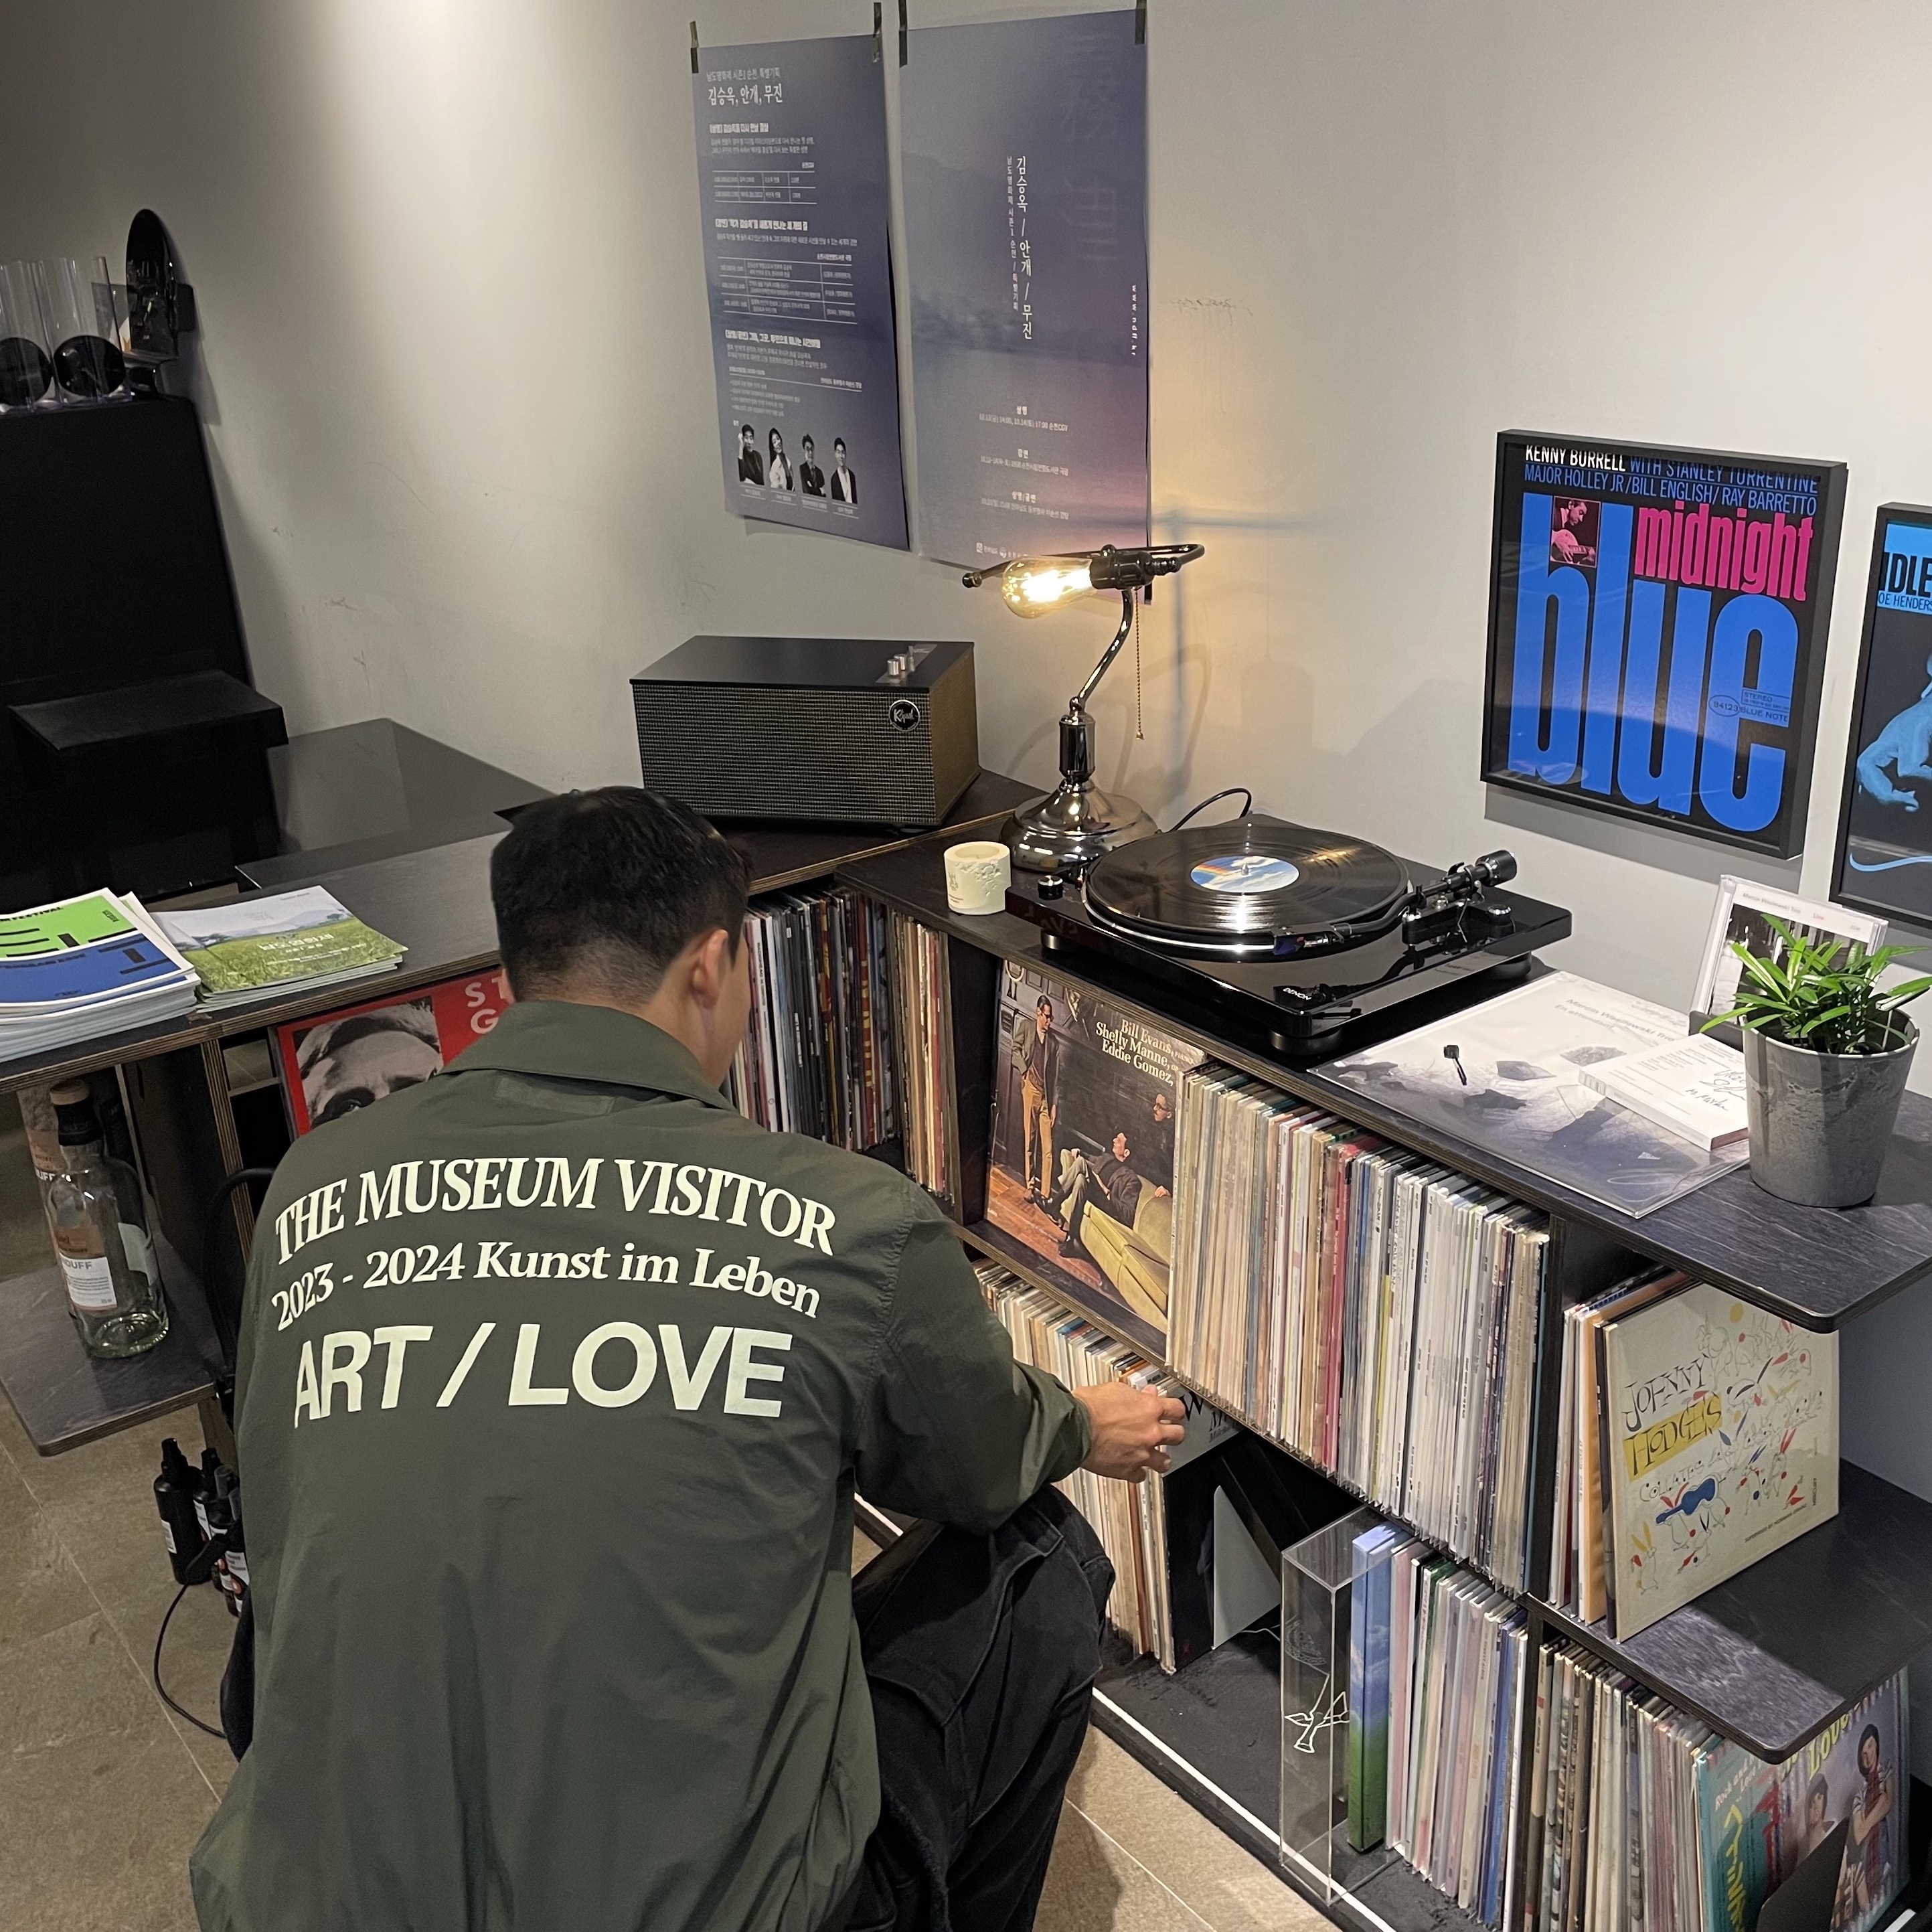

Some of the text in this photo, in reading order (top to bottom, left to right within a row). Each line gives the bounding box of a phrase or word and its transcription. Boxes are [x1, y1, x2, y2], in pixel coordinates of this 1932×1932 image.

[708, 83, 783, 106] 김승옥, 안개, 무진
[1016, 155, 1028, 213] 김승옥
[1020, 240, 1032, 276] 안개
[1022, 304, 1032, 339] 무진
[1526, 444, 1566, 465] KENNY
[1570, 449, 1626, 472] BURRELL
[1524, 463, 1562, 485] MAJOR
[1564, 469, 1609, 490] HOLLEY
[1721, 487, 1746, 507] RAY
[1748, 489, 1817, 517] BARRETTO
[1634, 499, 1814, 602] midnight
[1508, 492, 1799, 833] blue
[1740, 706, 1788, 722] BLUE NOTE
[1743, 692, 1773, 703] STEREO
[1096, 1022, 1129, 1050] Shelly
[1129, 1038, 1170, 1071] Manne,
[1102, 1038, 1174, 1086] Eddie Gomez,
[1121, 1019, 1139, 1039] Bill
[1141, 1028, 1175, 1057] Evans,
[275, 1157, 837, 1265] THE MUSEUM VISITOR
[271, 1262, 334, 1331] 2023
[363, 1242, 465, 1290] 2024
[474, 1240, 610, 1281] Kunst
[617, 1242, 679, 1283] im
[688, 1247, 821, 1318] Leben
[294, 1321, 793, 1428] ART / LOVE
[1623, 1389, 1722, 1476] HODGES
